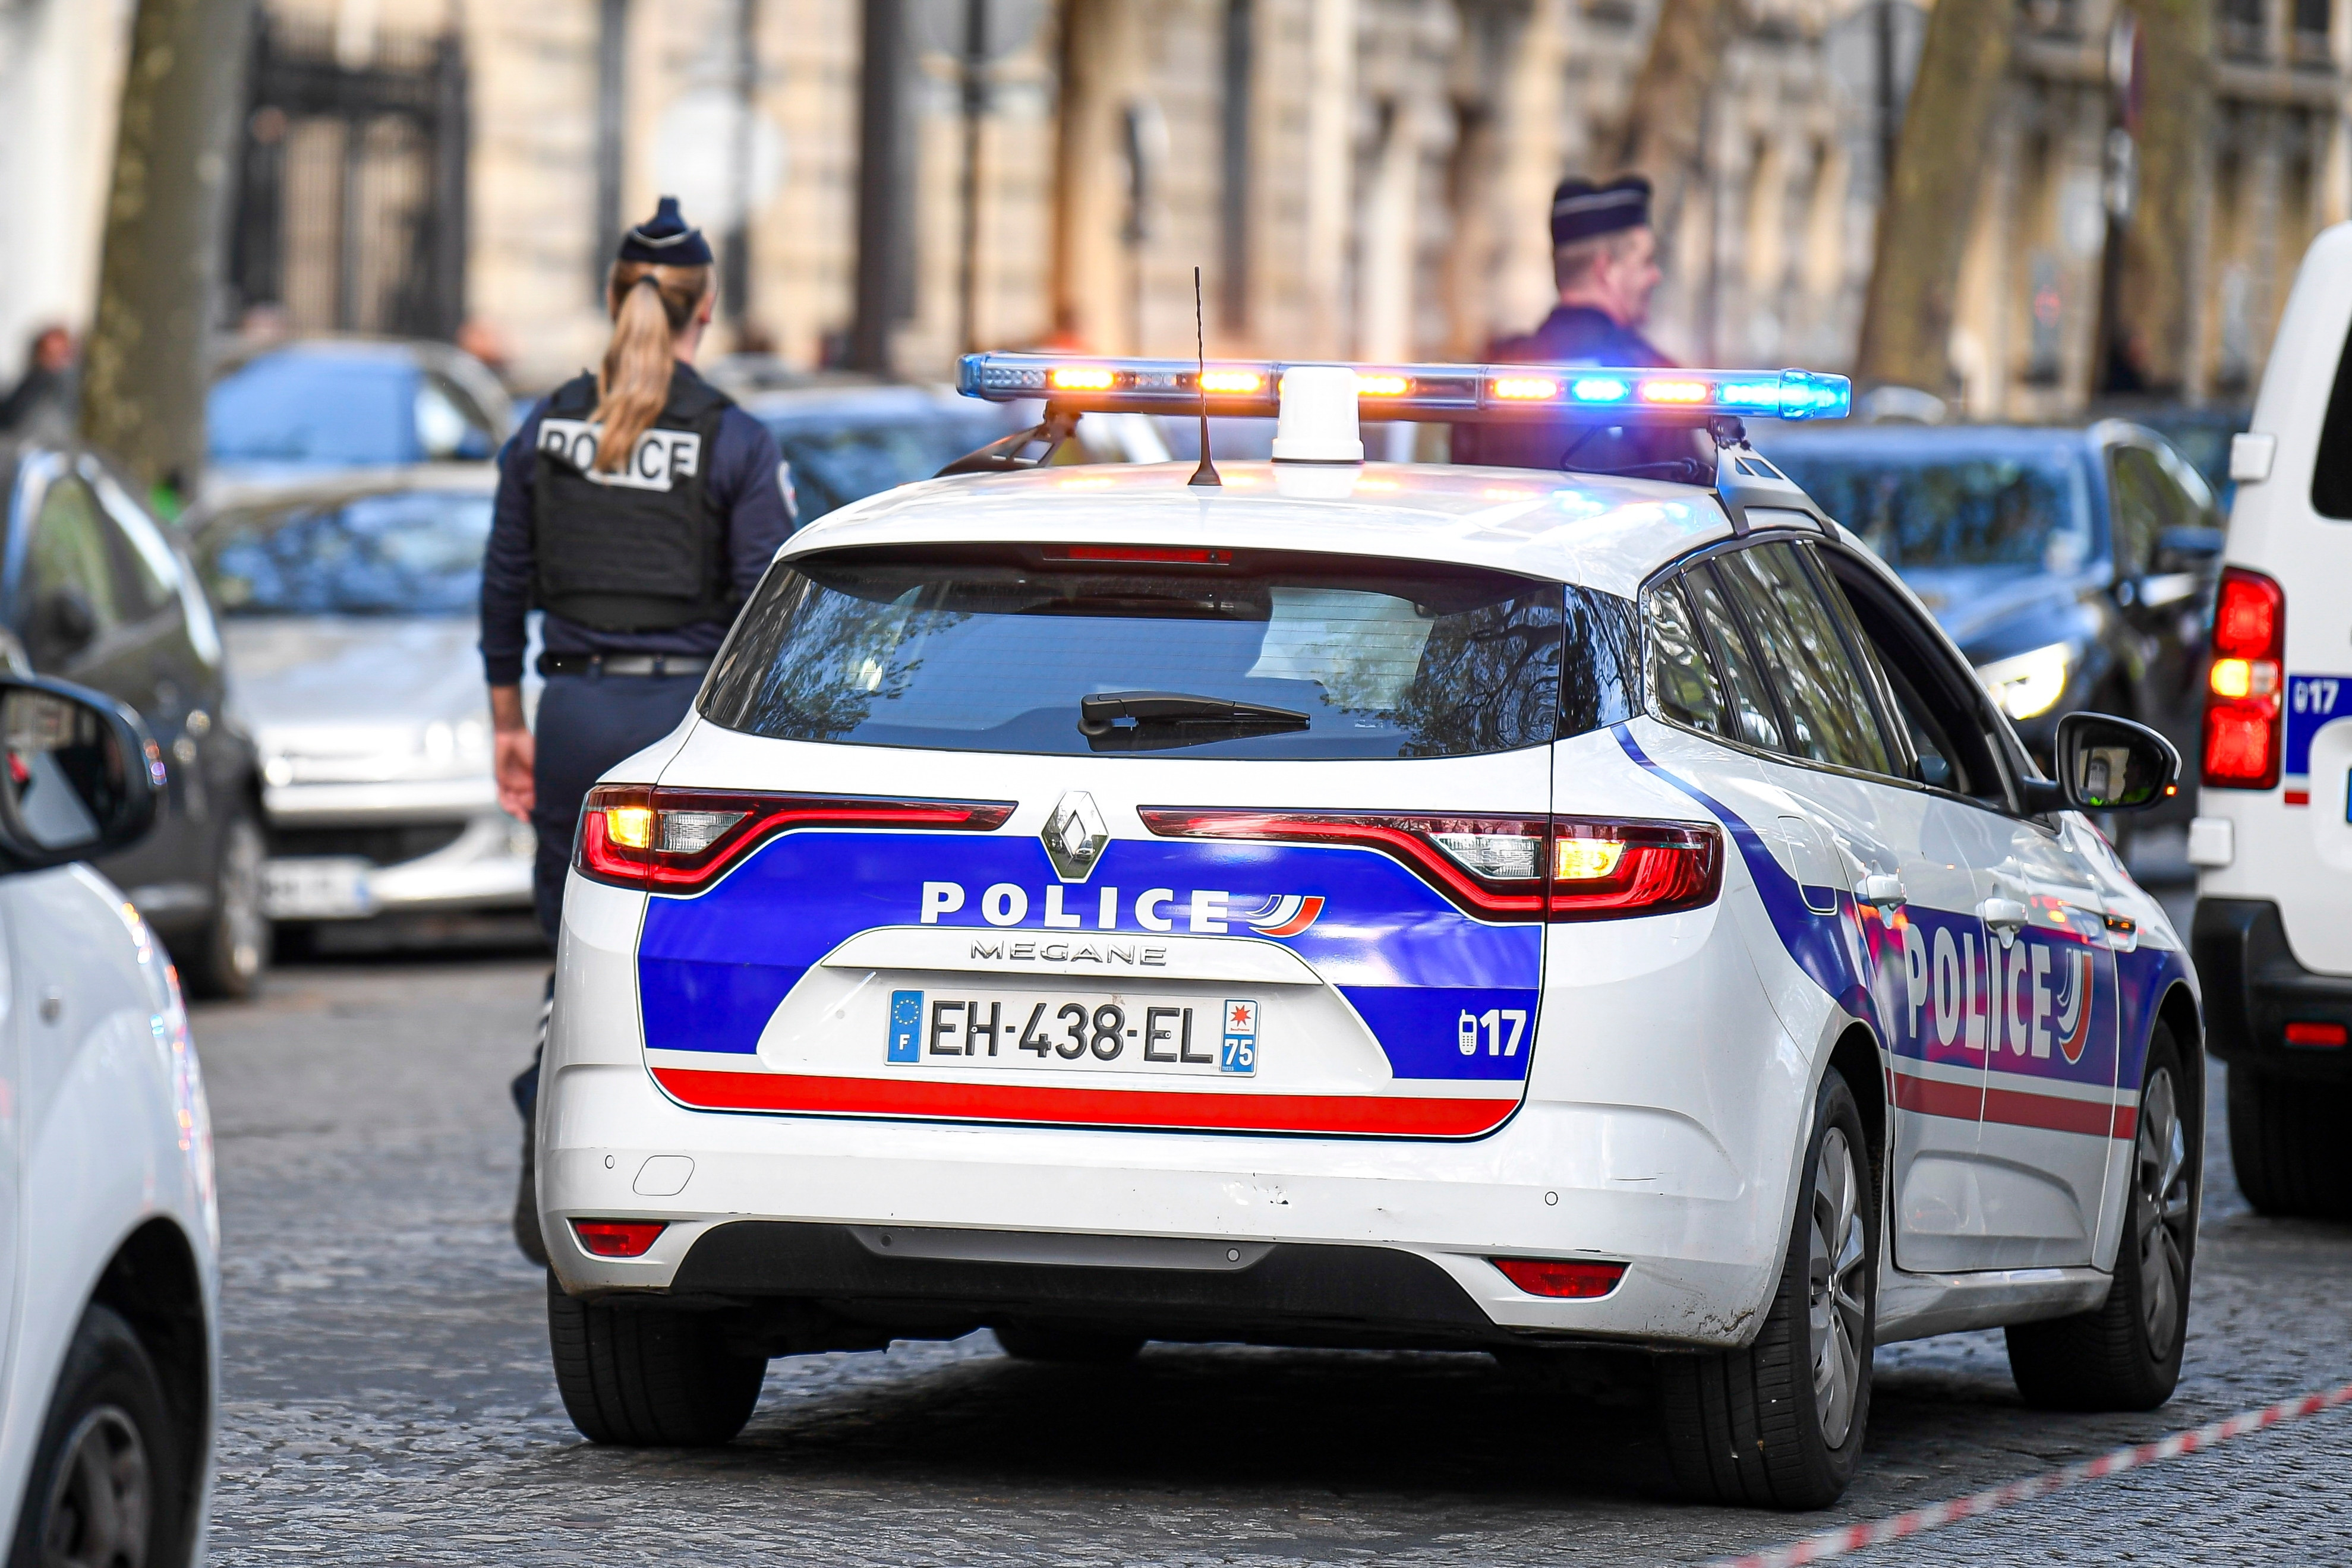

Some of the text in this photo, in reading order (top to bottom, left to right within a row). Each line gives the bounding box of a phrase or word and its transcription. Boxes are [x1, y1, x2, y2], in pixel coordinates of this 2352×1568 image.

[547, 430, 692, 480] POCE
[2309, 679, 2340, 714] 17
[920, 881, 1229, 934] POLICE
[970, 939, 1166, 966] MEGANE
[1901, 923, 2052, 1059] POLICE
[898, 1034, 910, 1050] F
[929, 1000, 1214, 1064] EH-438-EL
[1225, 1038, 1253, 1066] 75
[1480, 1009, 1527, 1056] 17
